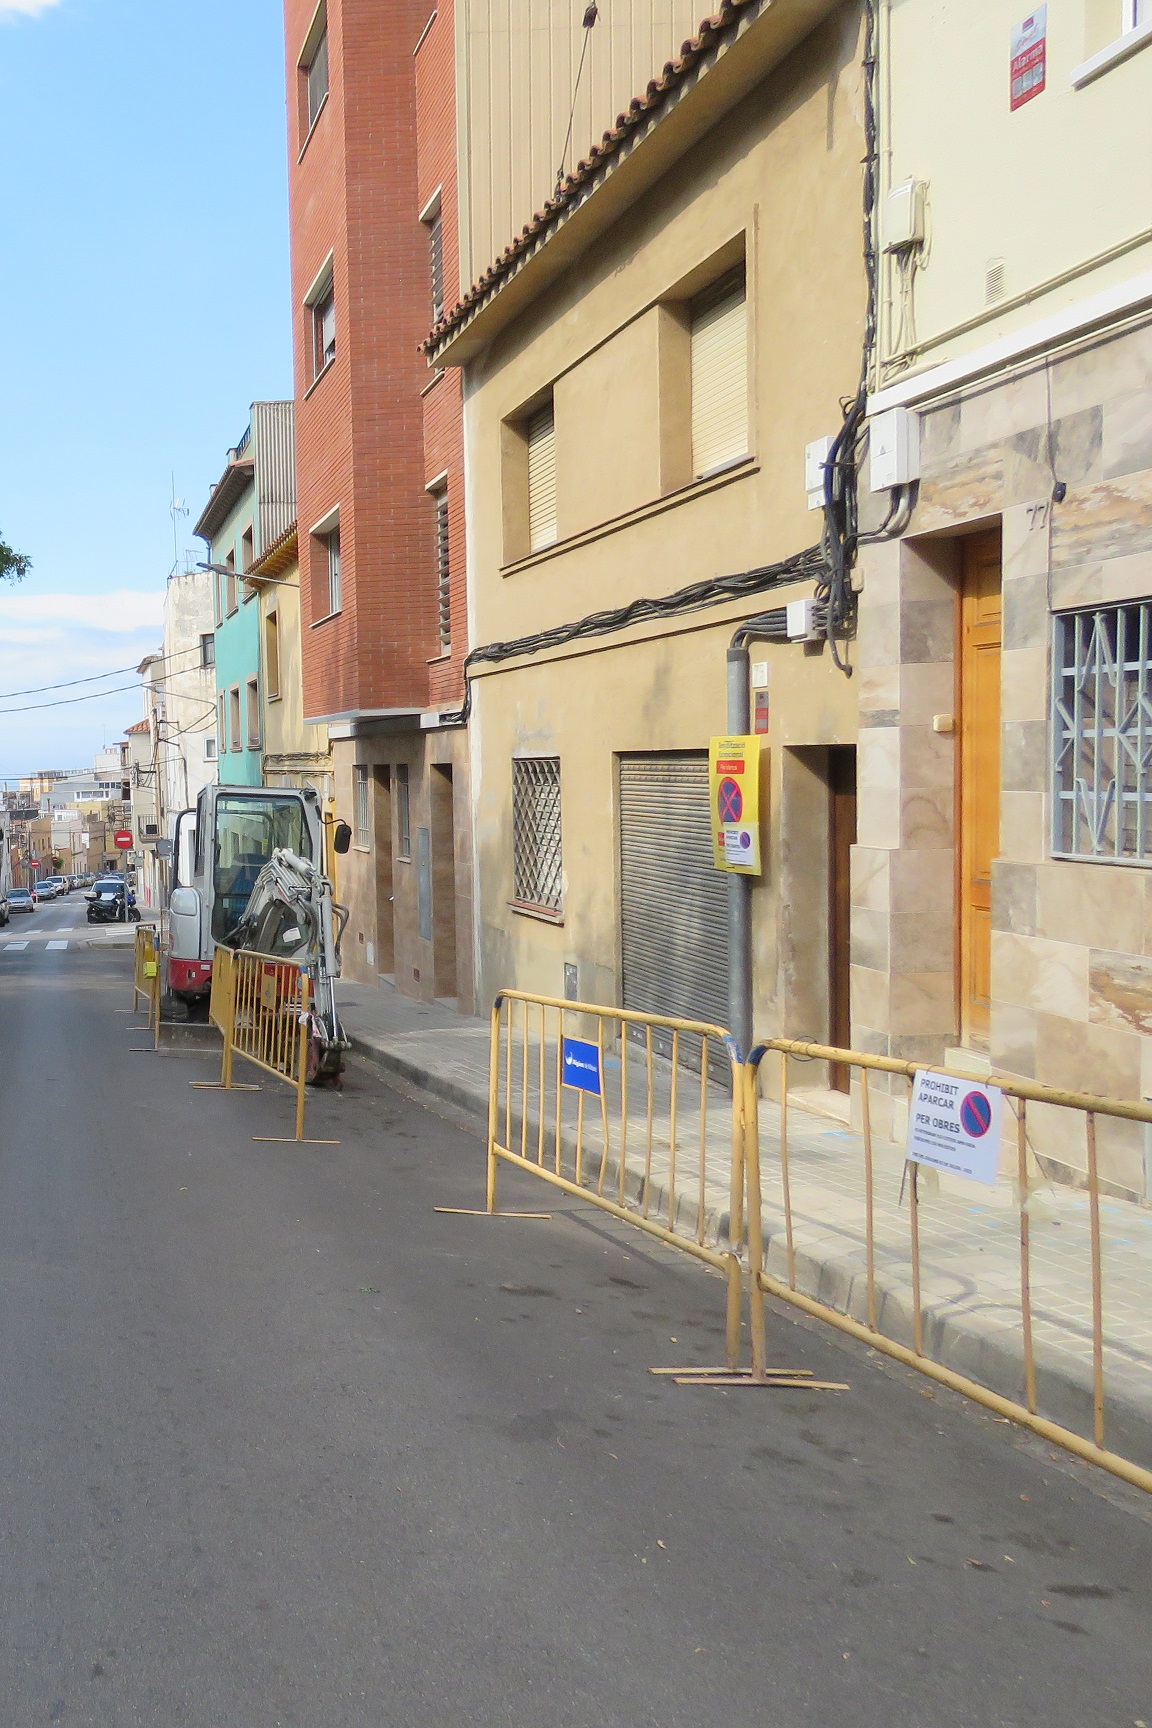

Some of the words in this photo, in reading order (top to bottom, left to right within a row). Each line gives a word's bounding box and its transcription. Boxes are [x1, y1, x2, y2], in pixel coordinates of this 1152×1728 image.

[1012, 44, 1043, 72] Alarma
[1026, 502, 1049, 531] 77
[920, 1078, 960, 1096] PROHIBIT
[918, 1092, 955, 1110] APARCAR
[916, 1112, 930, 1126] PER
[933, 1118, 960, 1134] OBRES
